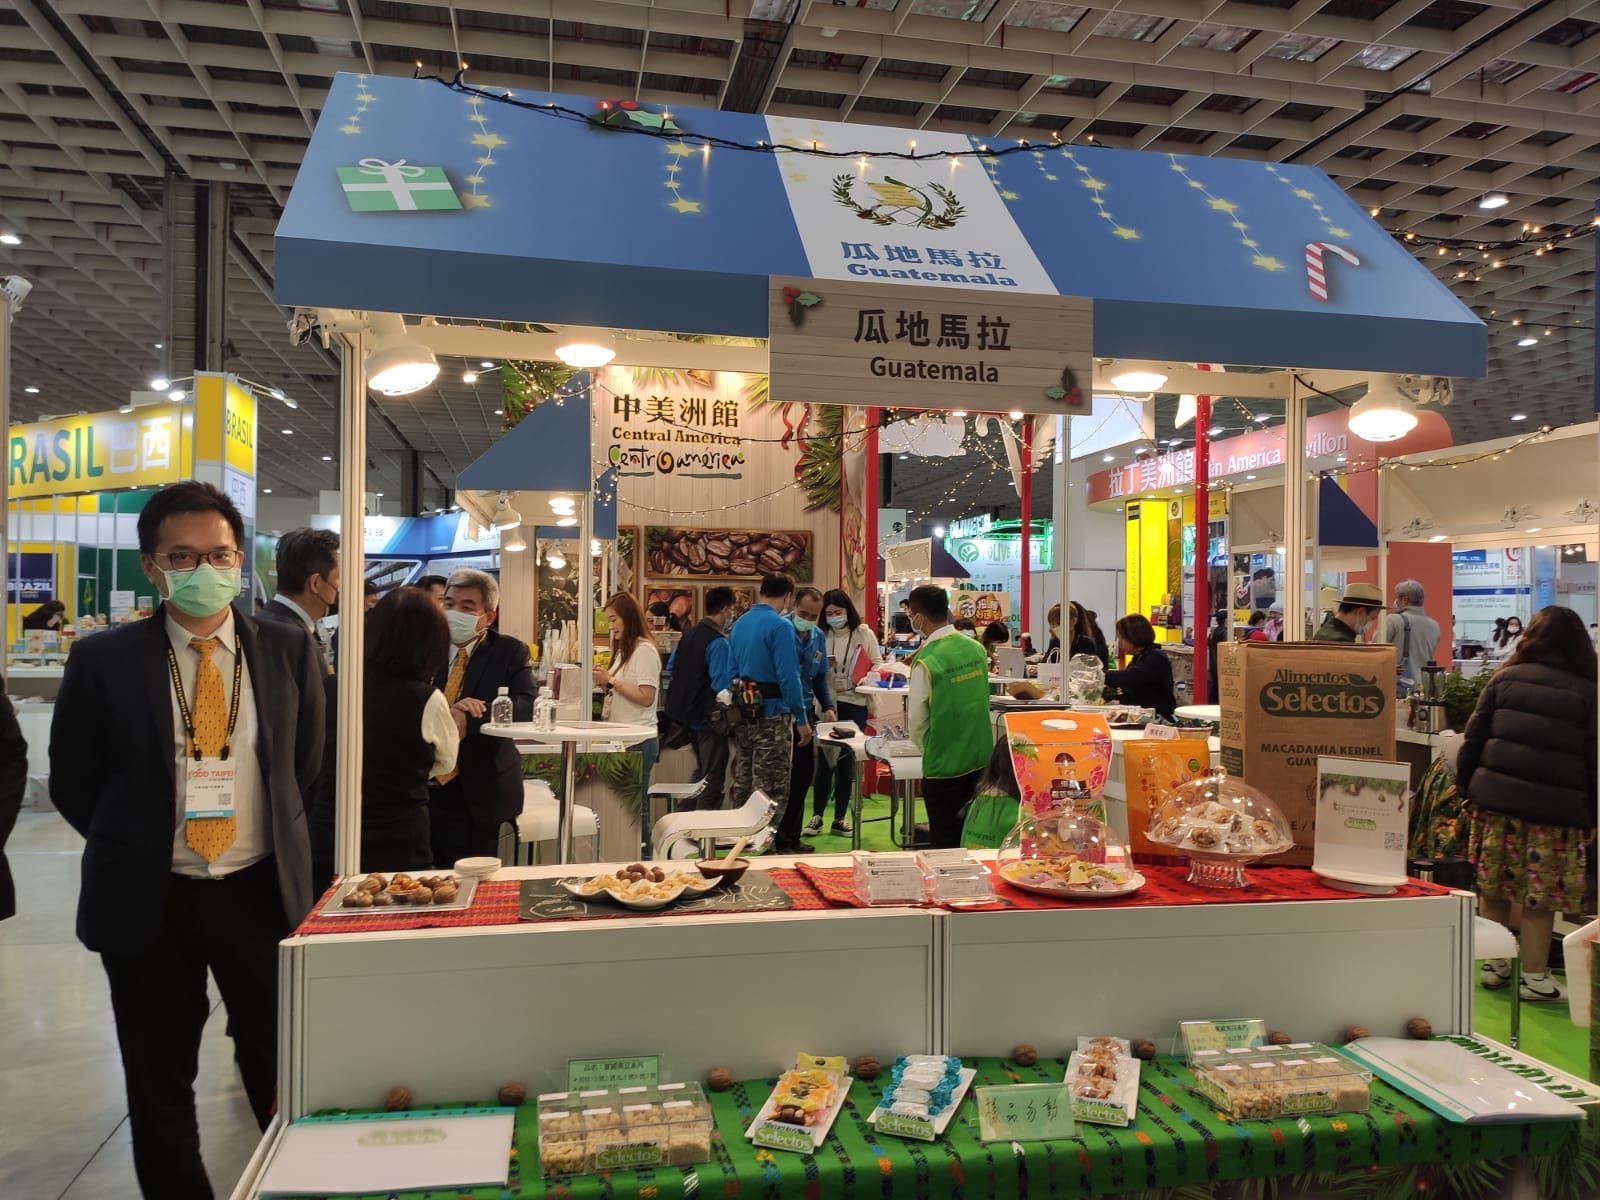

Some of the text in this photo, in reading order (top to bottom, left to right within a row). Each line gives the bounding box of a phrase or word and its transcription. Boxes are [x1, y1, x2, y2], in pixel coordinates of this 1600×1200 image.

[841, 241, 1008, 271] 瓜地馬拉
[846, 263, 1018, 287] Guatemala
[854, 308, 1012, 352] 瓜地馬拉
[869, 356, 1000, 383] Guatemala
[613, 393, 739, 428] 中美洲館
[226, 407, 254, 449] BRASIL
[611, 426, 741, 445] Central America
[9, 426, 104, 486] RASIL
[110, 416, 173, 474] 巴西
[1227, 447, 1281, 473] America
[1108, 451, 1194, 498] 拉丁美洲館
[1274, 669, 1350, 685] Alimentos
[1265, 685, 1380, 715] Selectos
[1261, 743, 1384, 757] MACADAMIA KERNEL
[1286, 757, 1318, 767] GUAT
[1072, 1104, 1126, 1123] Selectos
[755, 1129, 813, 1152] Selectos
[877, 1117, 932, 1138] Selectos
[599, 1147, 659, 1166] Selectos
